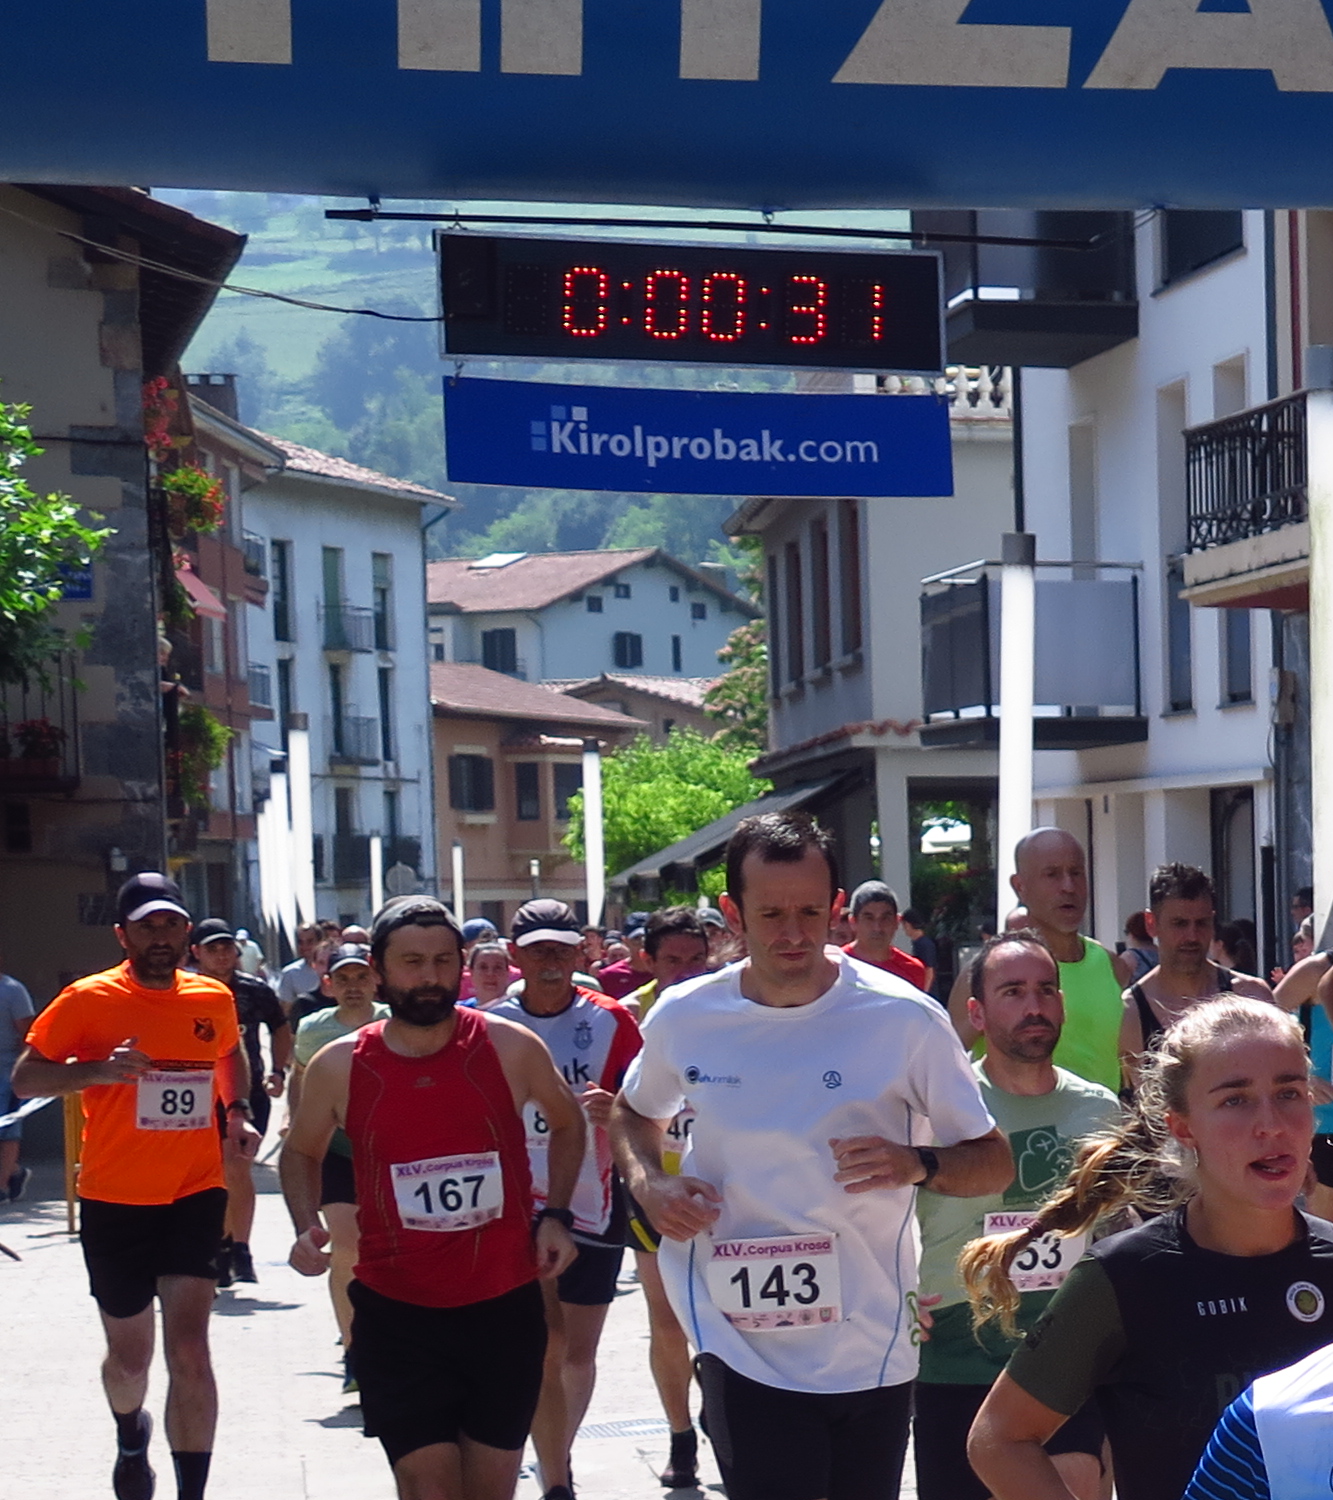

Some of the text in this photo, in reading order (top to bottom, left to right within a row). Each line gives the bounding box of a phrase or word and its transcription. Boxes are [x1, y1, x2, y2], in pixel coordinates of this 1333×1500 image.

[563, 266, 883, 345] 0:00:31
[551, 419, 879, 468] Kirolprobak.com
[161, 1089, 195, 1115] 89
[414, 1174, 485, 1214] 167
[795, 1240, 831, 1251] Krosa
[730, 1262, 820, 1308] 143
[1197, 1297, 1248, 1316] GOBIK
